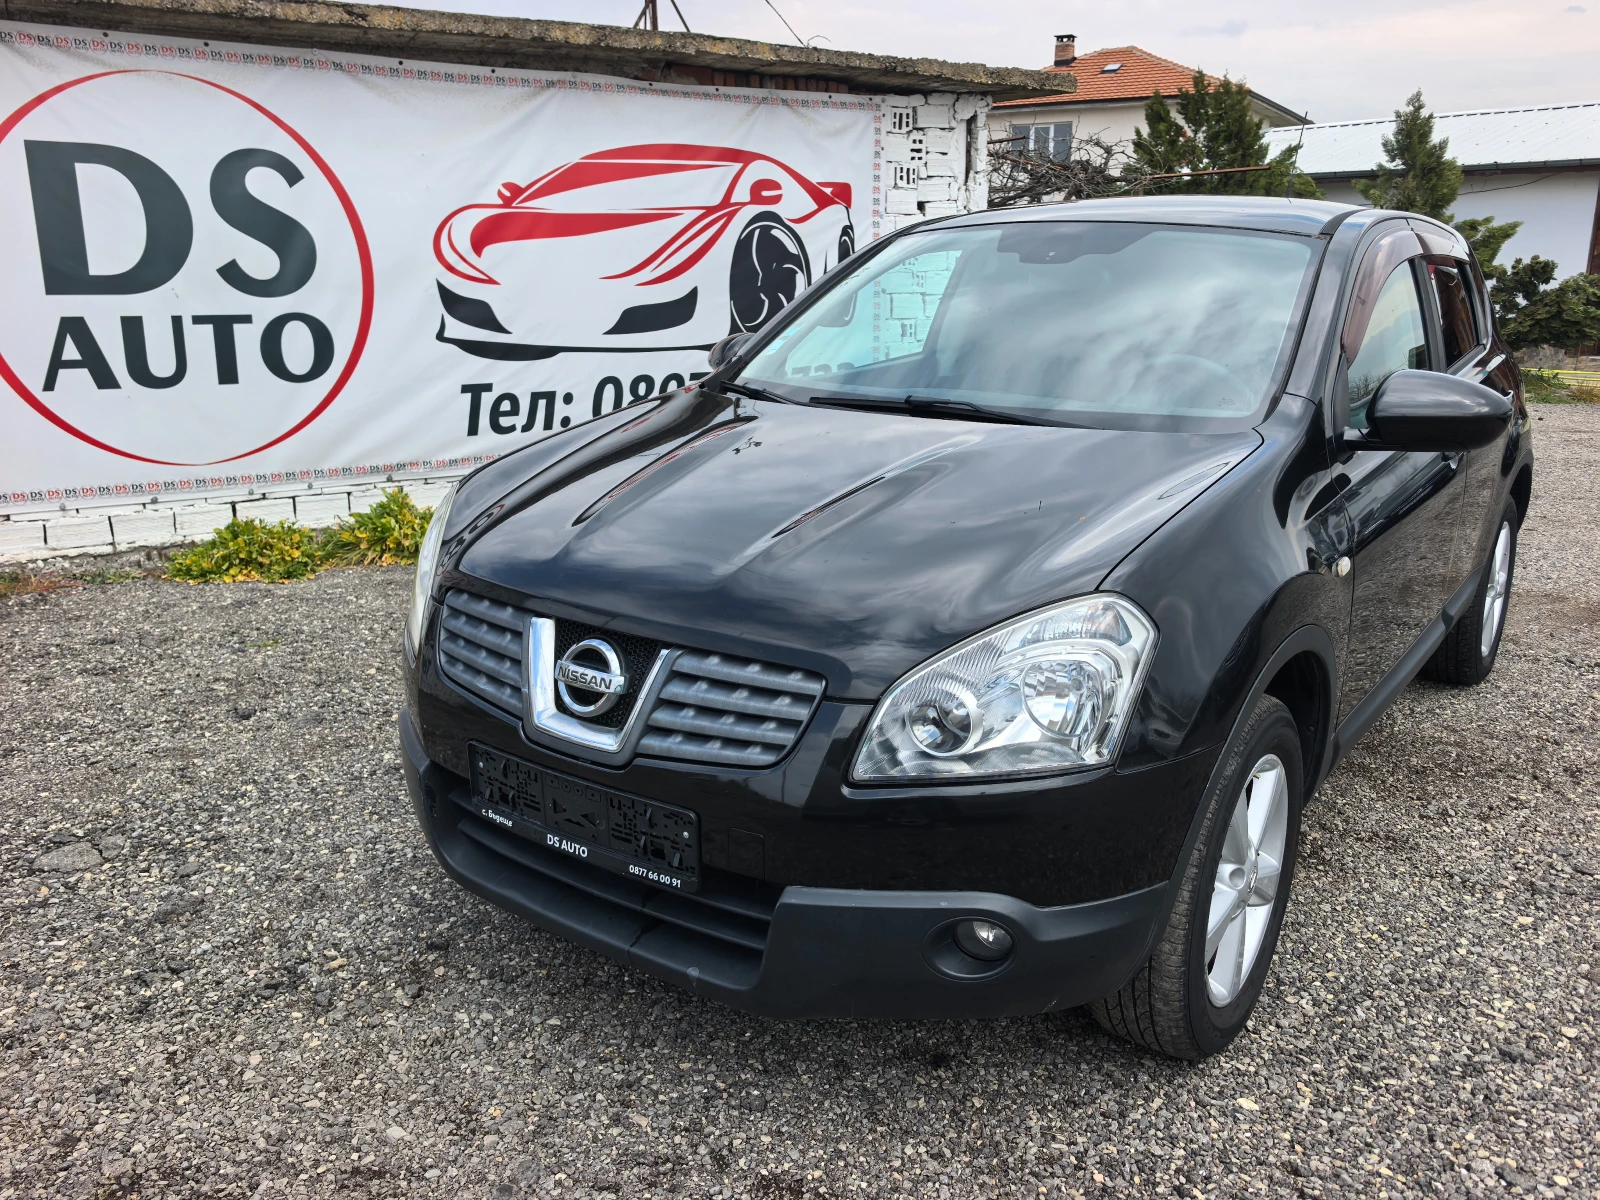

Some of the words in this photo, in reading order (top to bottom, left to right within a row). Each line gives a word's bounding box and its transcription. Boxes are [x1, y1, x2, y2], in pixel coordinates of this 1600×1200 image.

[0, 31, 13, 39] DS
[55, 36, 68, 44] DS
[74, 38, 86, 46] DS
[109, 41, 122, 49] DS
[144, 44, 156, 52] DS
[210, 50, 222, 58] DS
[24, 139, 318, 298] DS
[42, 312, 335, 392] AUTO
[460, 382, 574, 437] Тел:
[557, 665, 613, 690] NISSAN
[547, 833, 560, 847] DS
[561, 839, 588, 858] AUTO
[629, 864, 647, 877] 0877
[648, 871, 658, 881] 66
[659, 874, 671, 884] 00
[671, 878, 681, 888] 91
